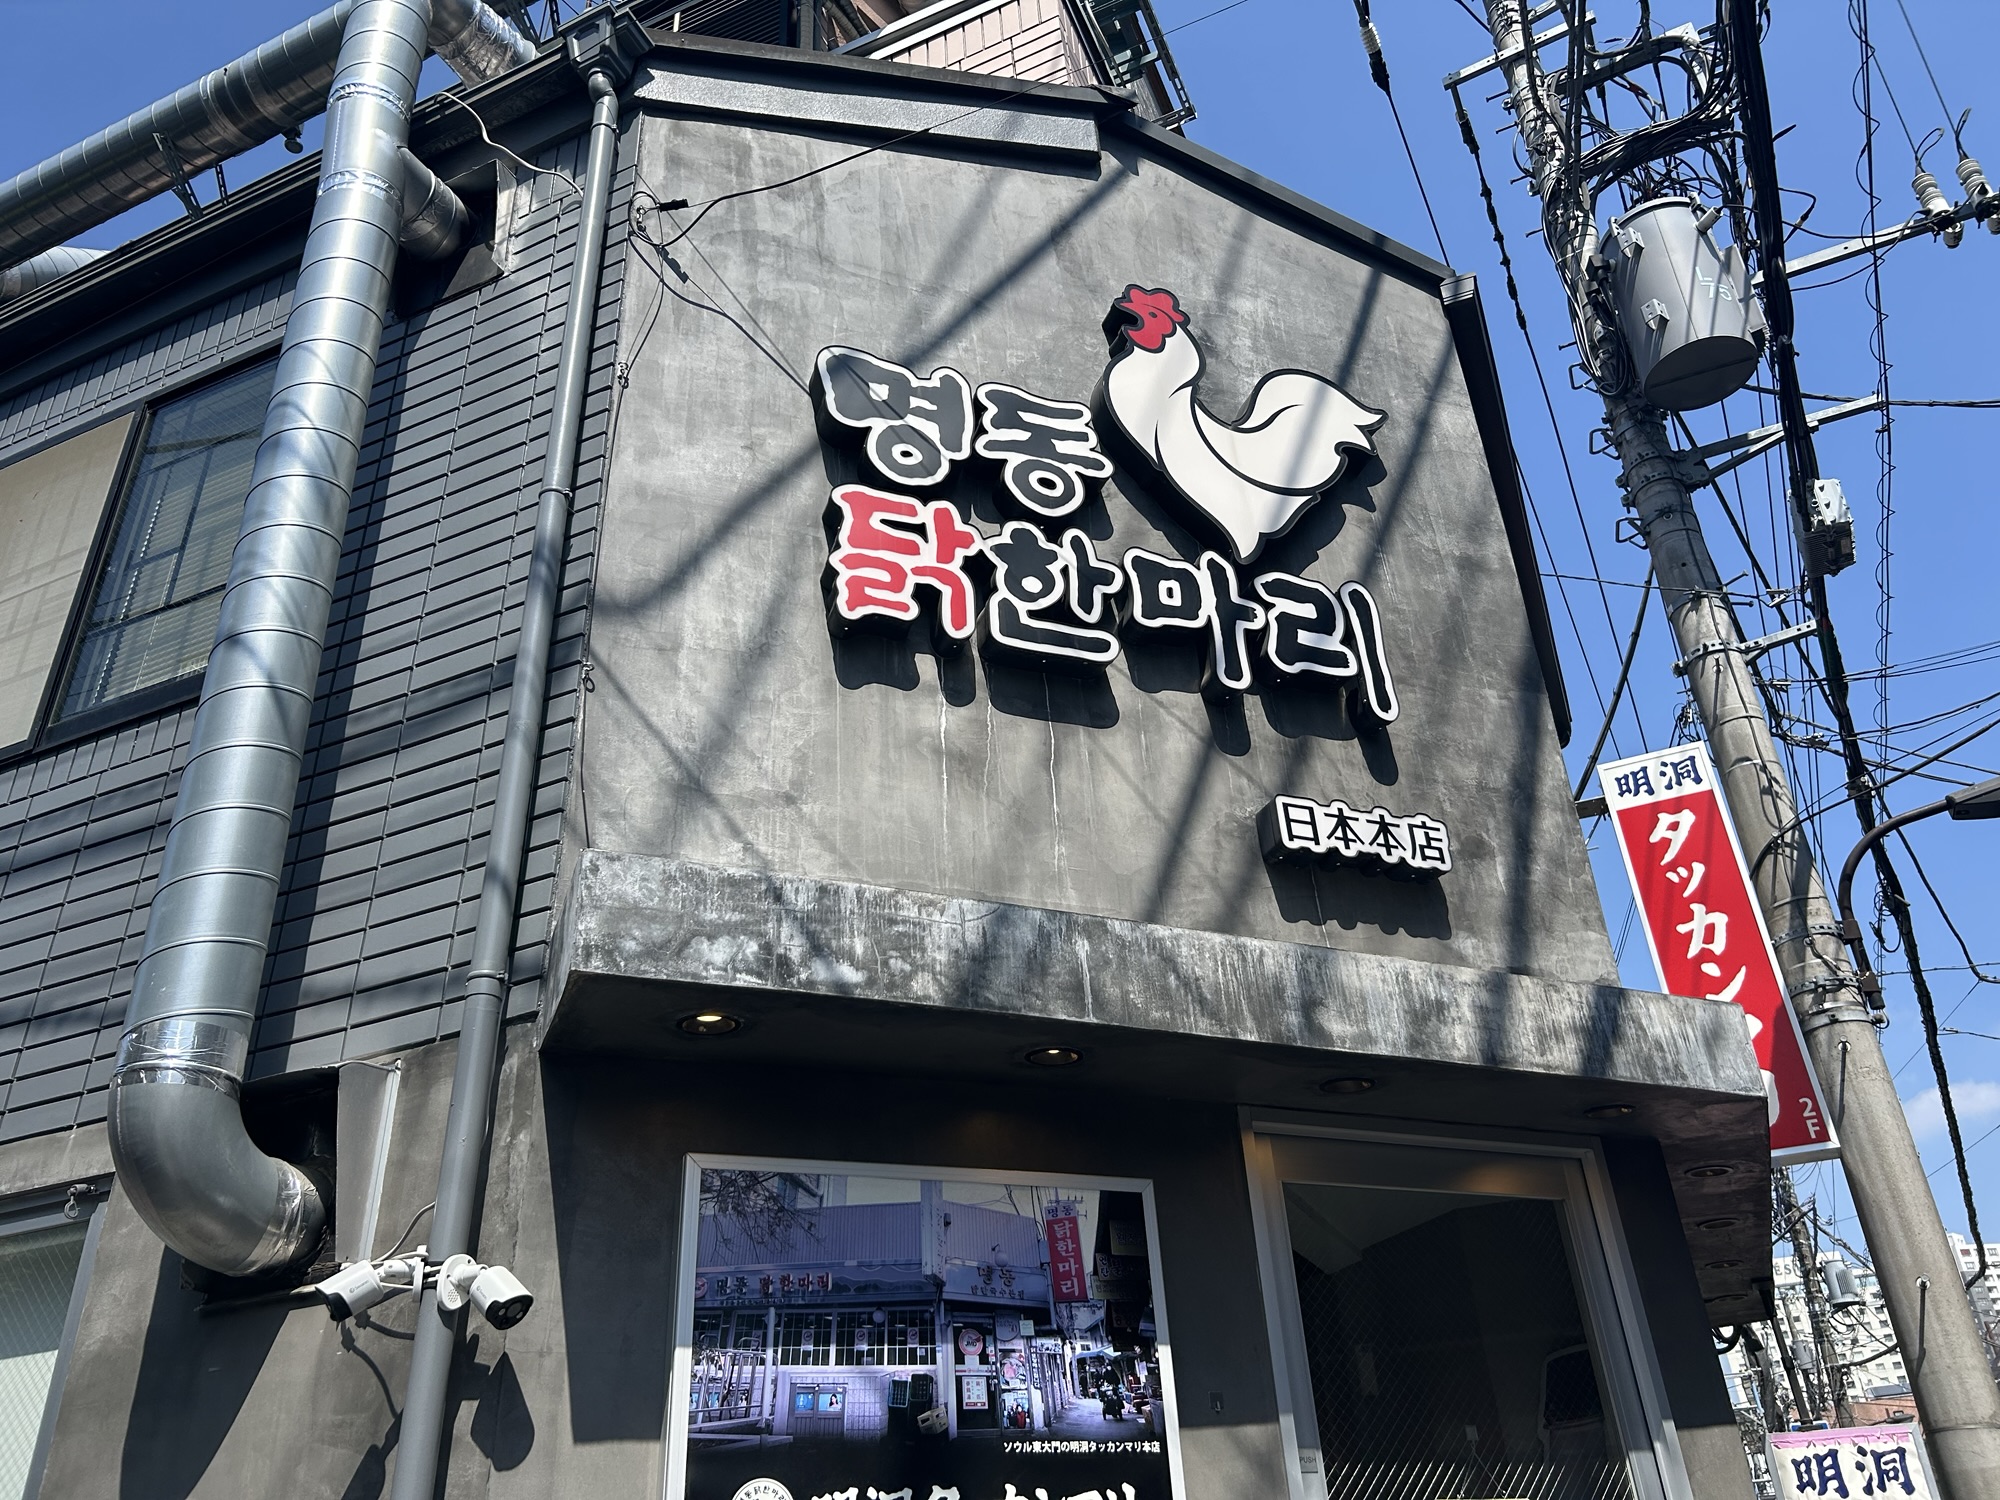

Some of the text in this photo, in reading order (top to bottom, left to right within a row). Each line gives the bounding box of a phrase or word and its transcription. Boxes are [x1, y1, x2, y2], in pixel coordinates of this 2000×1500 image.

[818, 346, 1113, 516] 명동
[1615, 756, 1703, 797] 明洞
[1282, 802, 1446, 865] 日本本店
[1047, 1205, 1073, 1218] 명동
[977, 1266, 1016, 1287] 명동
[1053, 1220, 1079, 1297] 닭한마리
[1003, 1440, 1161, 1453] ソウル東大門の明洞タッカンマリ本店
[1299, 1456, 1316, 1464] PUSH
[1791, 1446, 1916, 1499] 明洞
